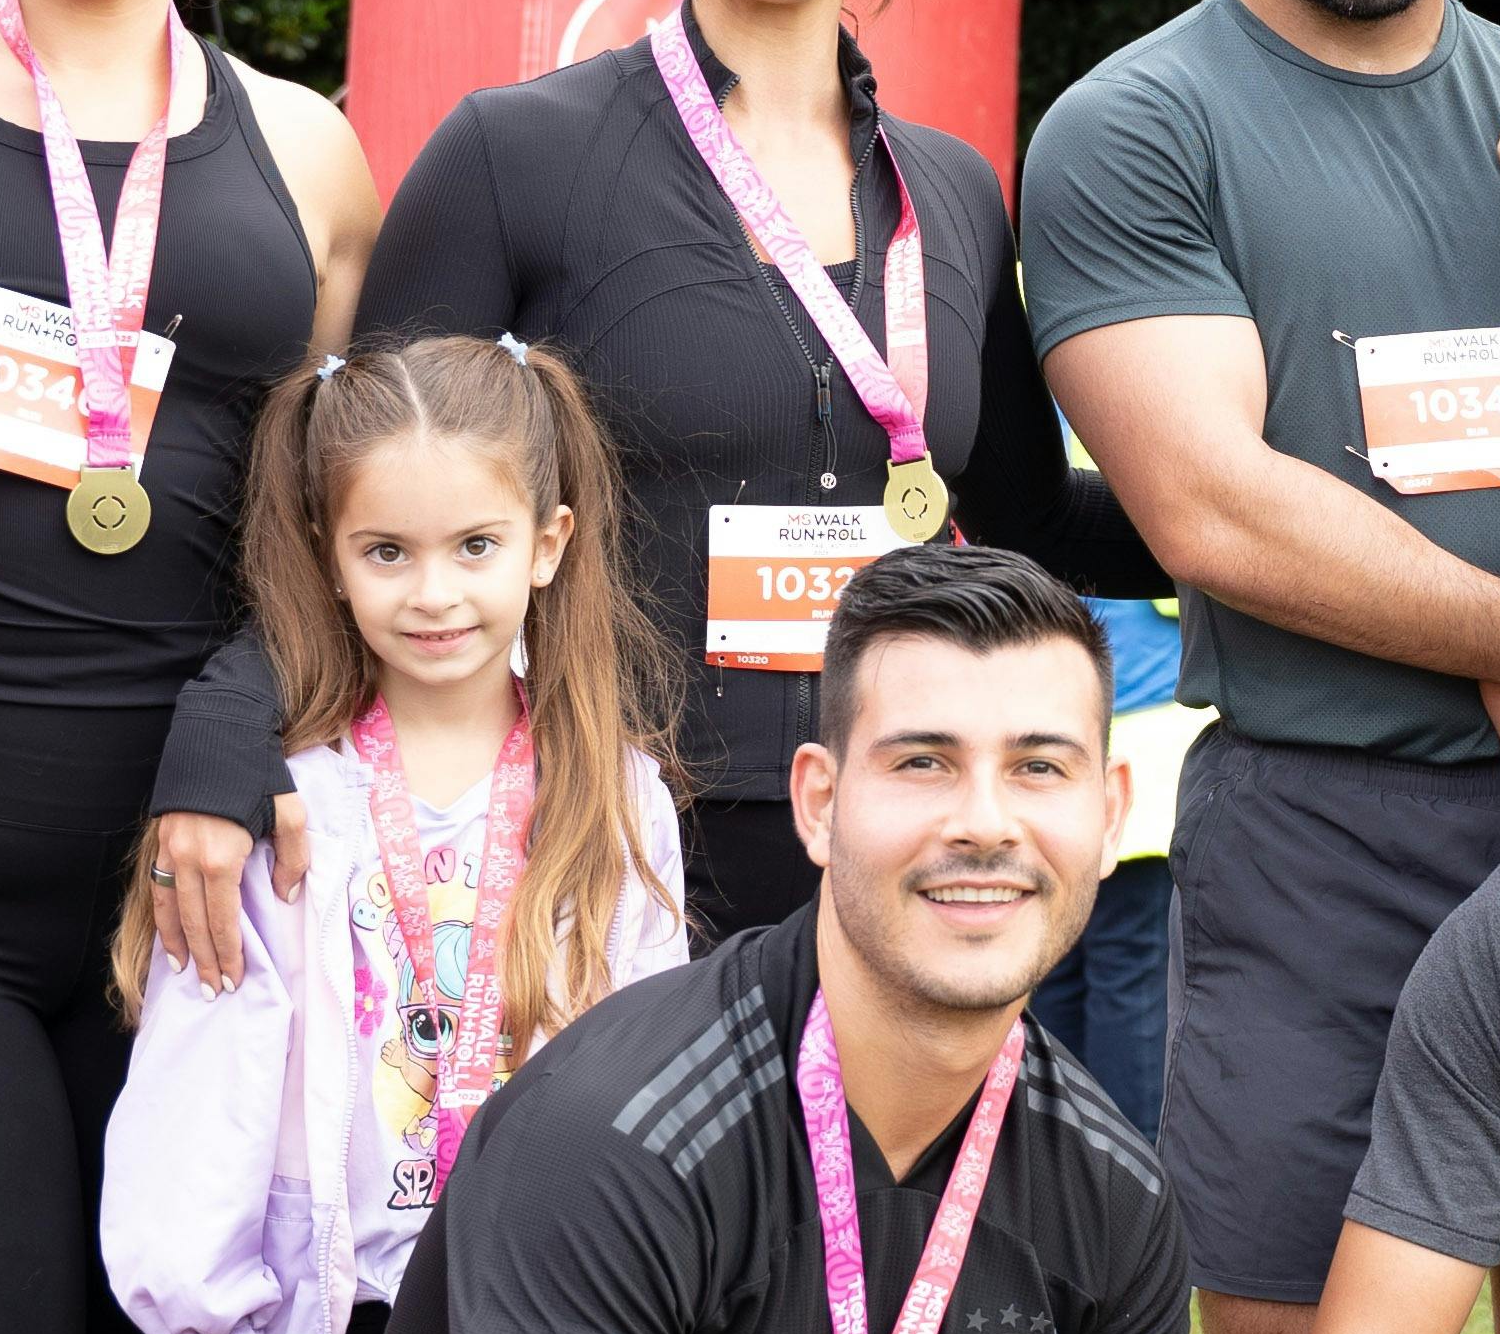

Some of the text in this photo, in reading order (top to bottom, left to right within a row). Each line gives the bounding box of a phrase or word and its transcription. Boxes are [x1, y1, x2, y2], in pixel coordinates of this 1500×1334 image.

[2, 314, 79, 347] RUN+RO
[1453, 334, 1500, 348] WALK
[780, 528, 867, 541] RUN+ROLL
[787, 514, 861, 525] MS WALK
[756, 566, 856, 601] 1032
[453, 973, 486, 1084] RUN+ROLL
[473, 973, 501, 1068] MS WALK
[924, 1284, 949, 1321] MS
